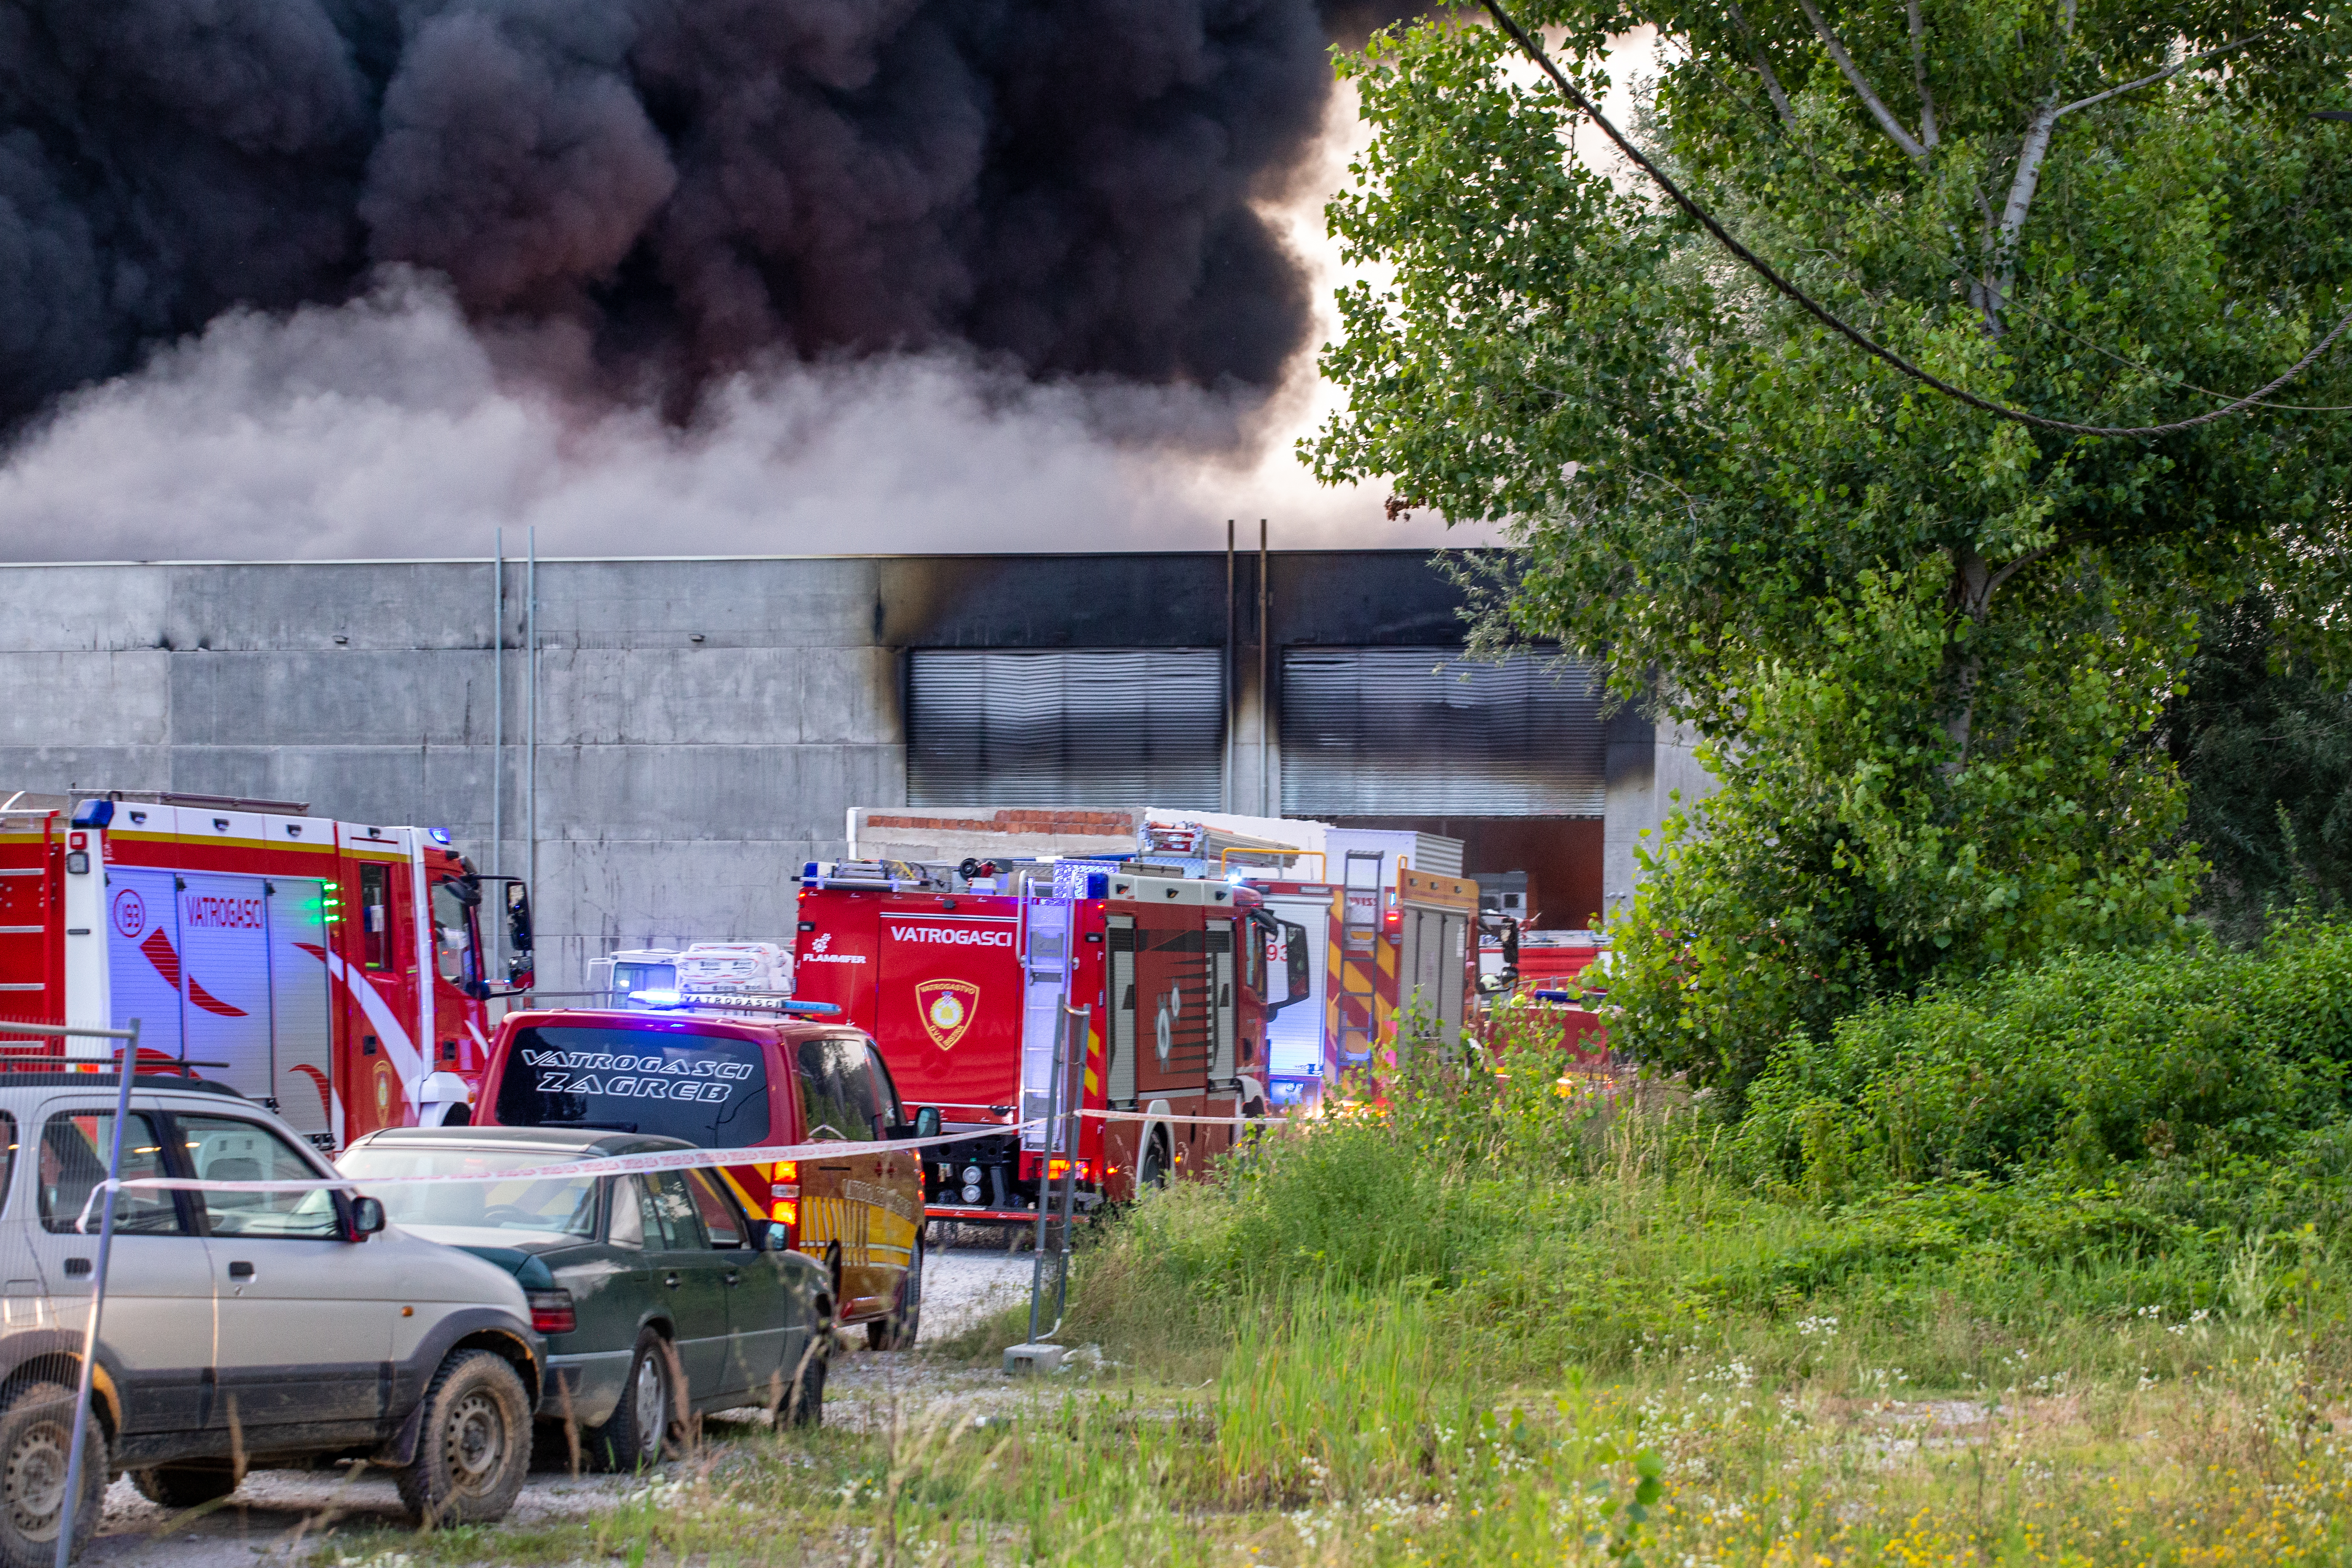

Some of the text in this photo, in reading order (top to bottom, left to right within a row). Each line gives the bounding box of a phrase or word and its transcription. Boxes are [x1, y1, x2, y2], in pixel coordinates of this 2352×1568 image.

[123, 903, 140, 927] 193
[185, 896, 263, 929] VATROGASCI
[891, 926, 1012, 947] VATROGASCI
[803, 953, 867, 964] FLAMMIFER
[685, 995, 779, 1008] VATROGASCI
[521, 1049, 754, 1080] VATROGASCI
[536, 1072, 733, 1103] ZAGREB
